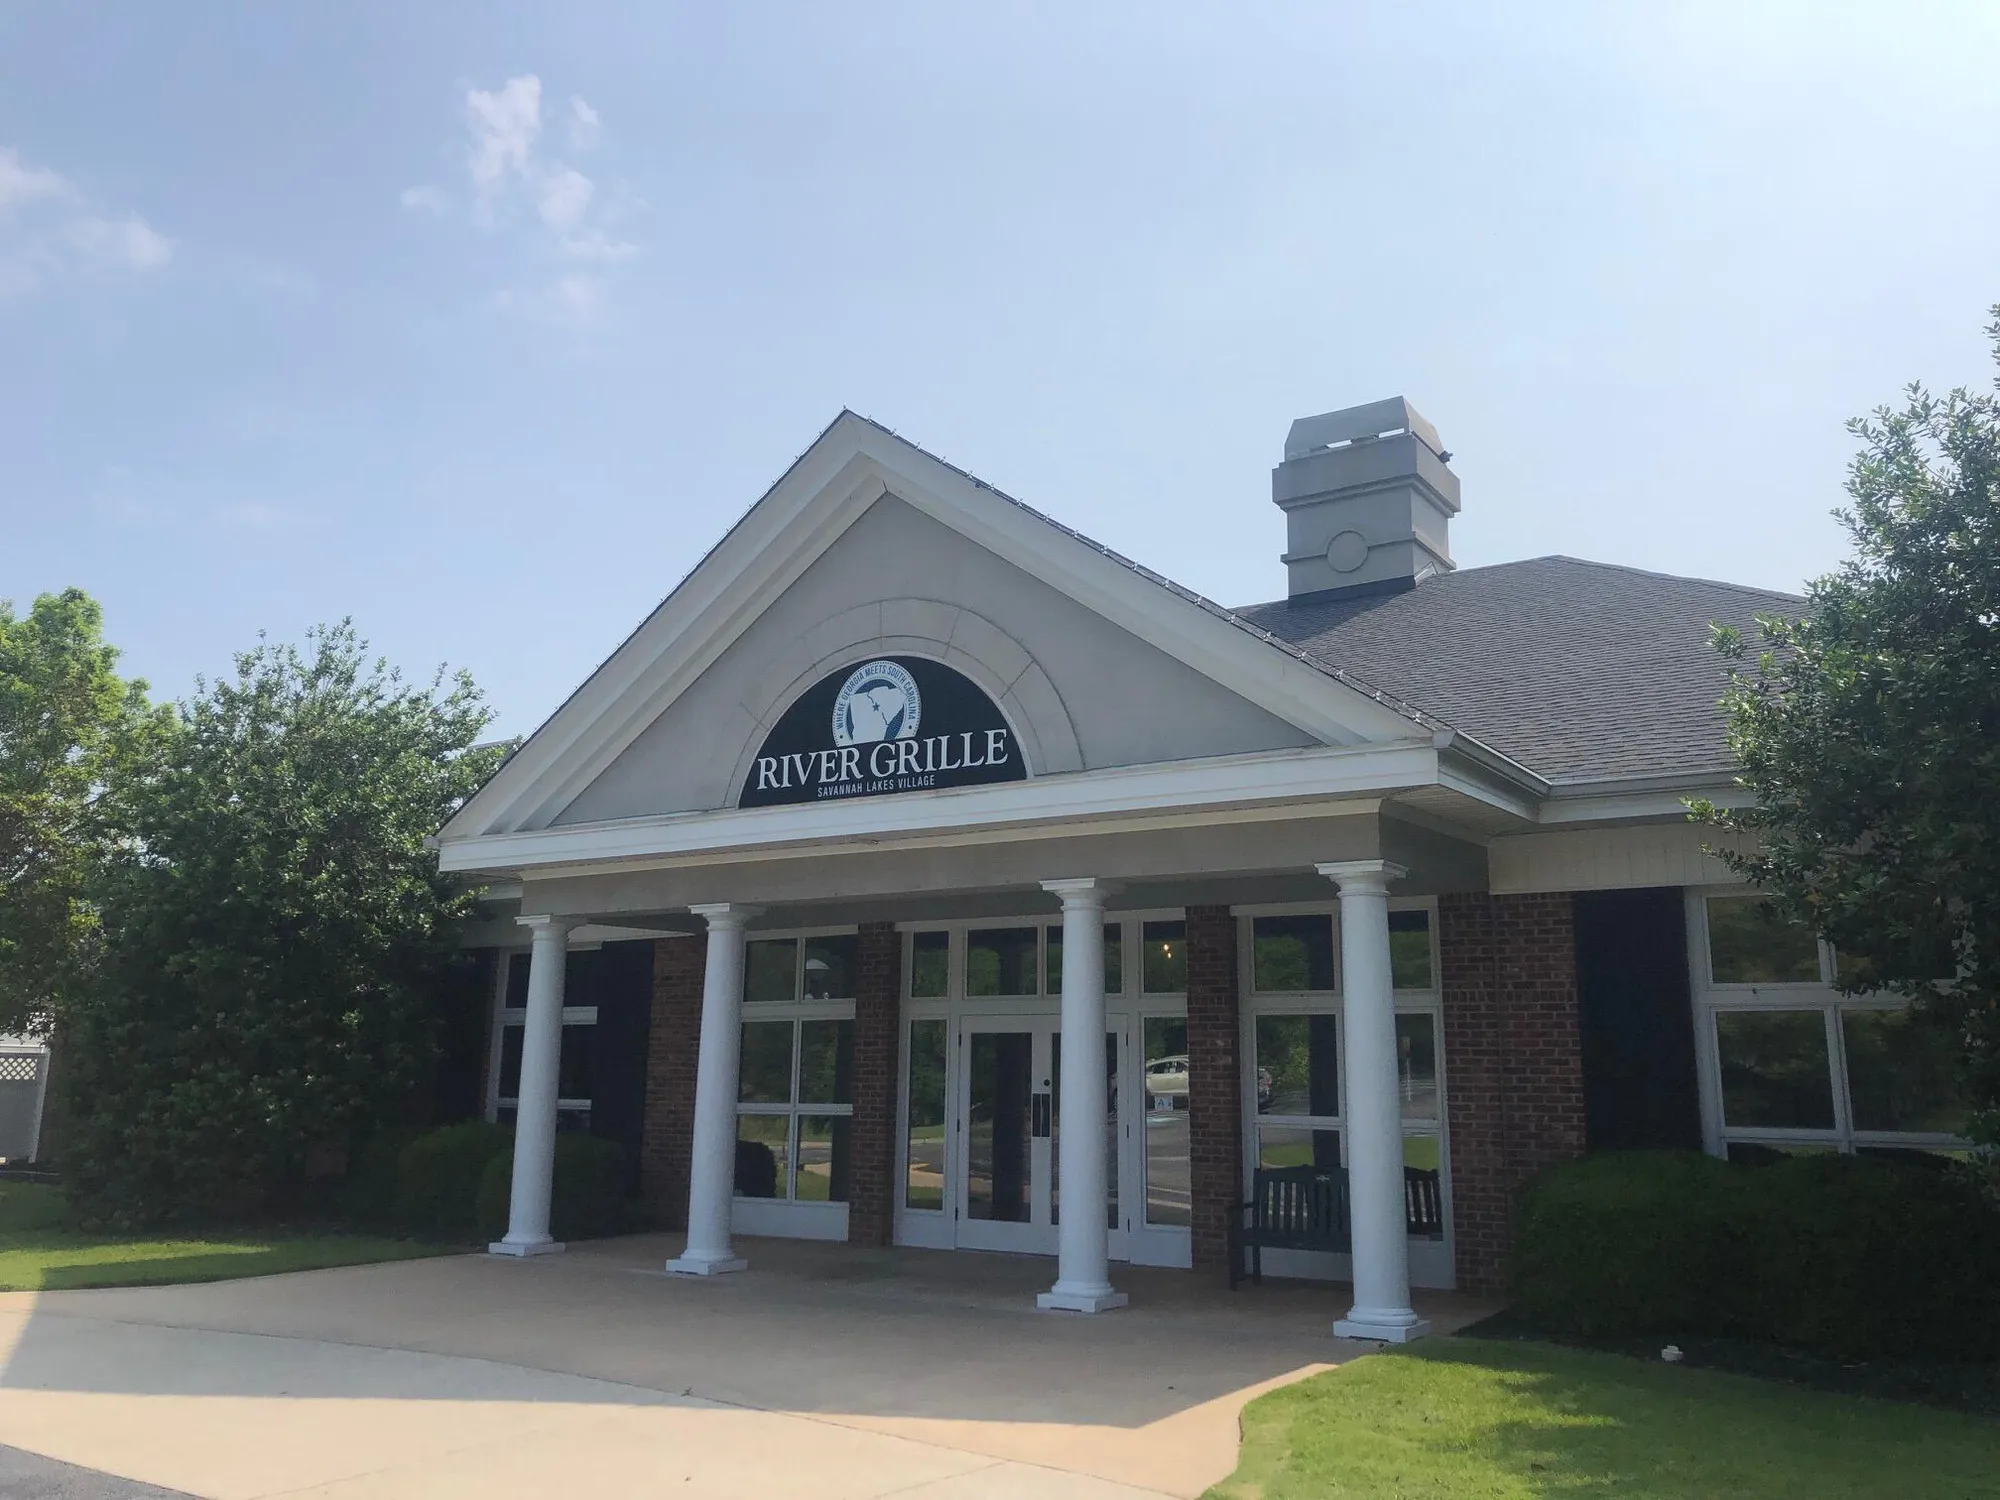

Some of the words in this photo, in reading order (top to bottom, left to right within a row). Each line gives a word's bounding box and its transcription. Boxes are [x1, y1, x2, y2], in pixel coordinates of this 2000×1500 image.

[836, 701, 846, 730] WHERE
[841, 672, 865, 701] GEORGIA
[865, 664, 887, 677] MEETS
[887, 665, 907, 684] SOUTH
[903, 681, 917, 720] CAROLINA
[757, 746, 864, 790] RIVER
[869, 728, 1009, 778] GRILLE
[817, 782, 863, 798] SAVANNAH
[866, 779, 894, 792] LAKES
[897, 774, 935, 789] VILLAGE
